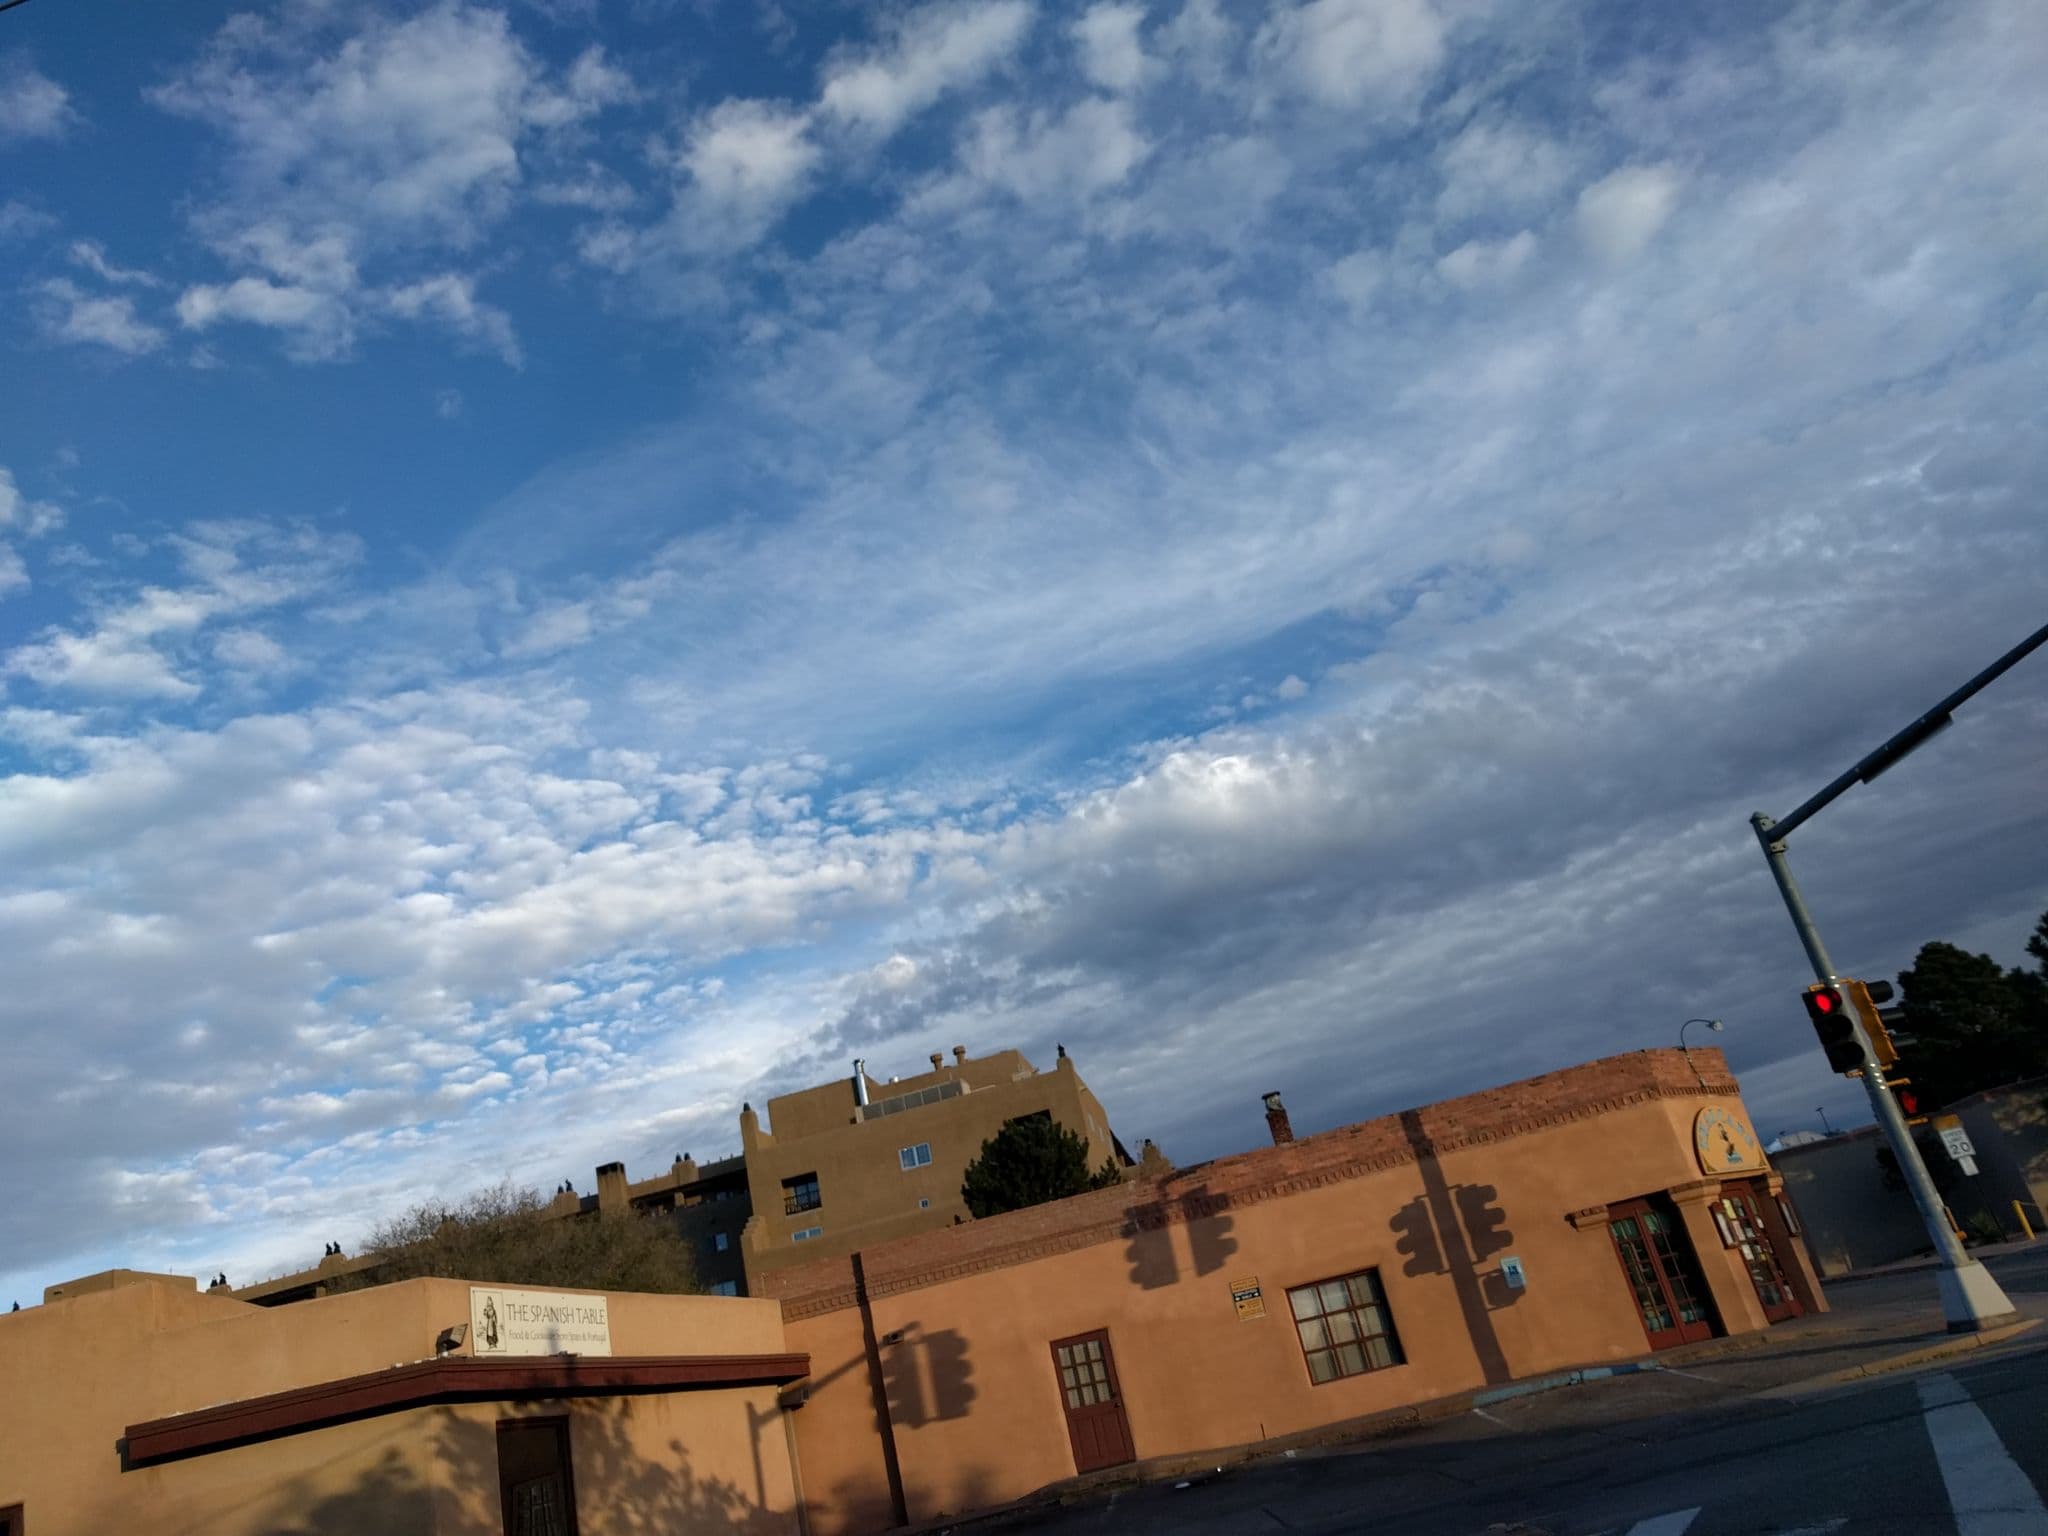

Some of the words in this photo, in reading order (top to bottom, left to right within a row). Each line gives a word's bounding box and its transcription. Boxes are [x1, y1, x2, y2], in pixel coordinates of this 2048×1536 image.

[1951, 1142, 1970, 1155] 20
[506, 1304, 529, 1322] THE
[530, 1305, 575, 1324] SPANISH
[575, 1308, 606, 1325] TABLE
[509, 1329, 524, 1341] Food
